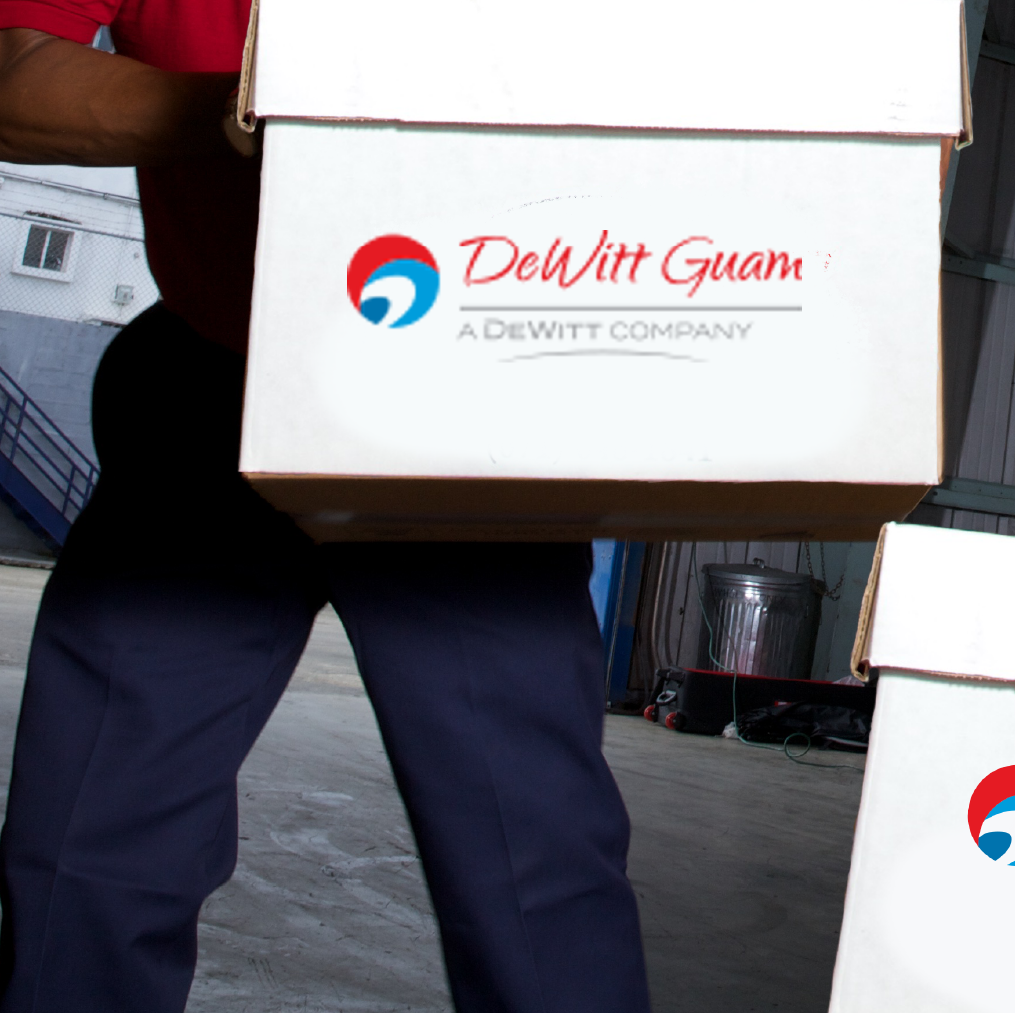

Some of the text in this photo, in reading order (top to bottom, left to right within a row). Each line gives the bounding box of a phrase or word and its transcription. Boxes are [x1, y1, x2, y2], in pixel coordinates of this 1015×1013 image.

[459, 230, 803, 298] DeWitt Guam
[457, 322, 477, 340] A
[608, 320, 752, 341] COMPANY
